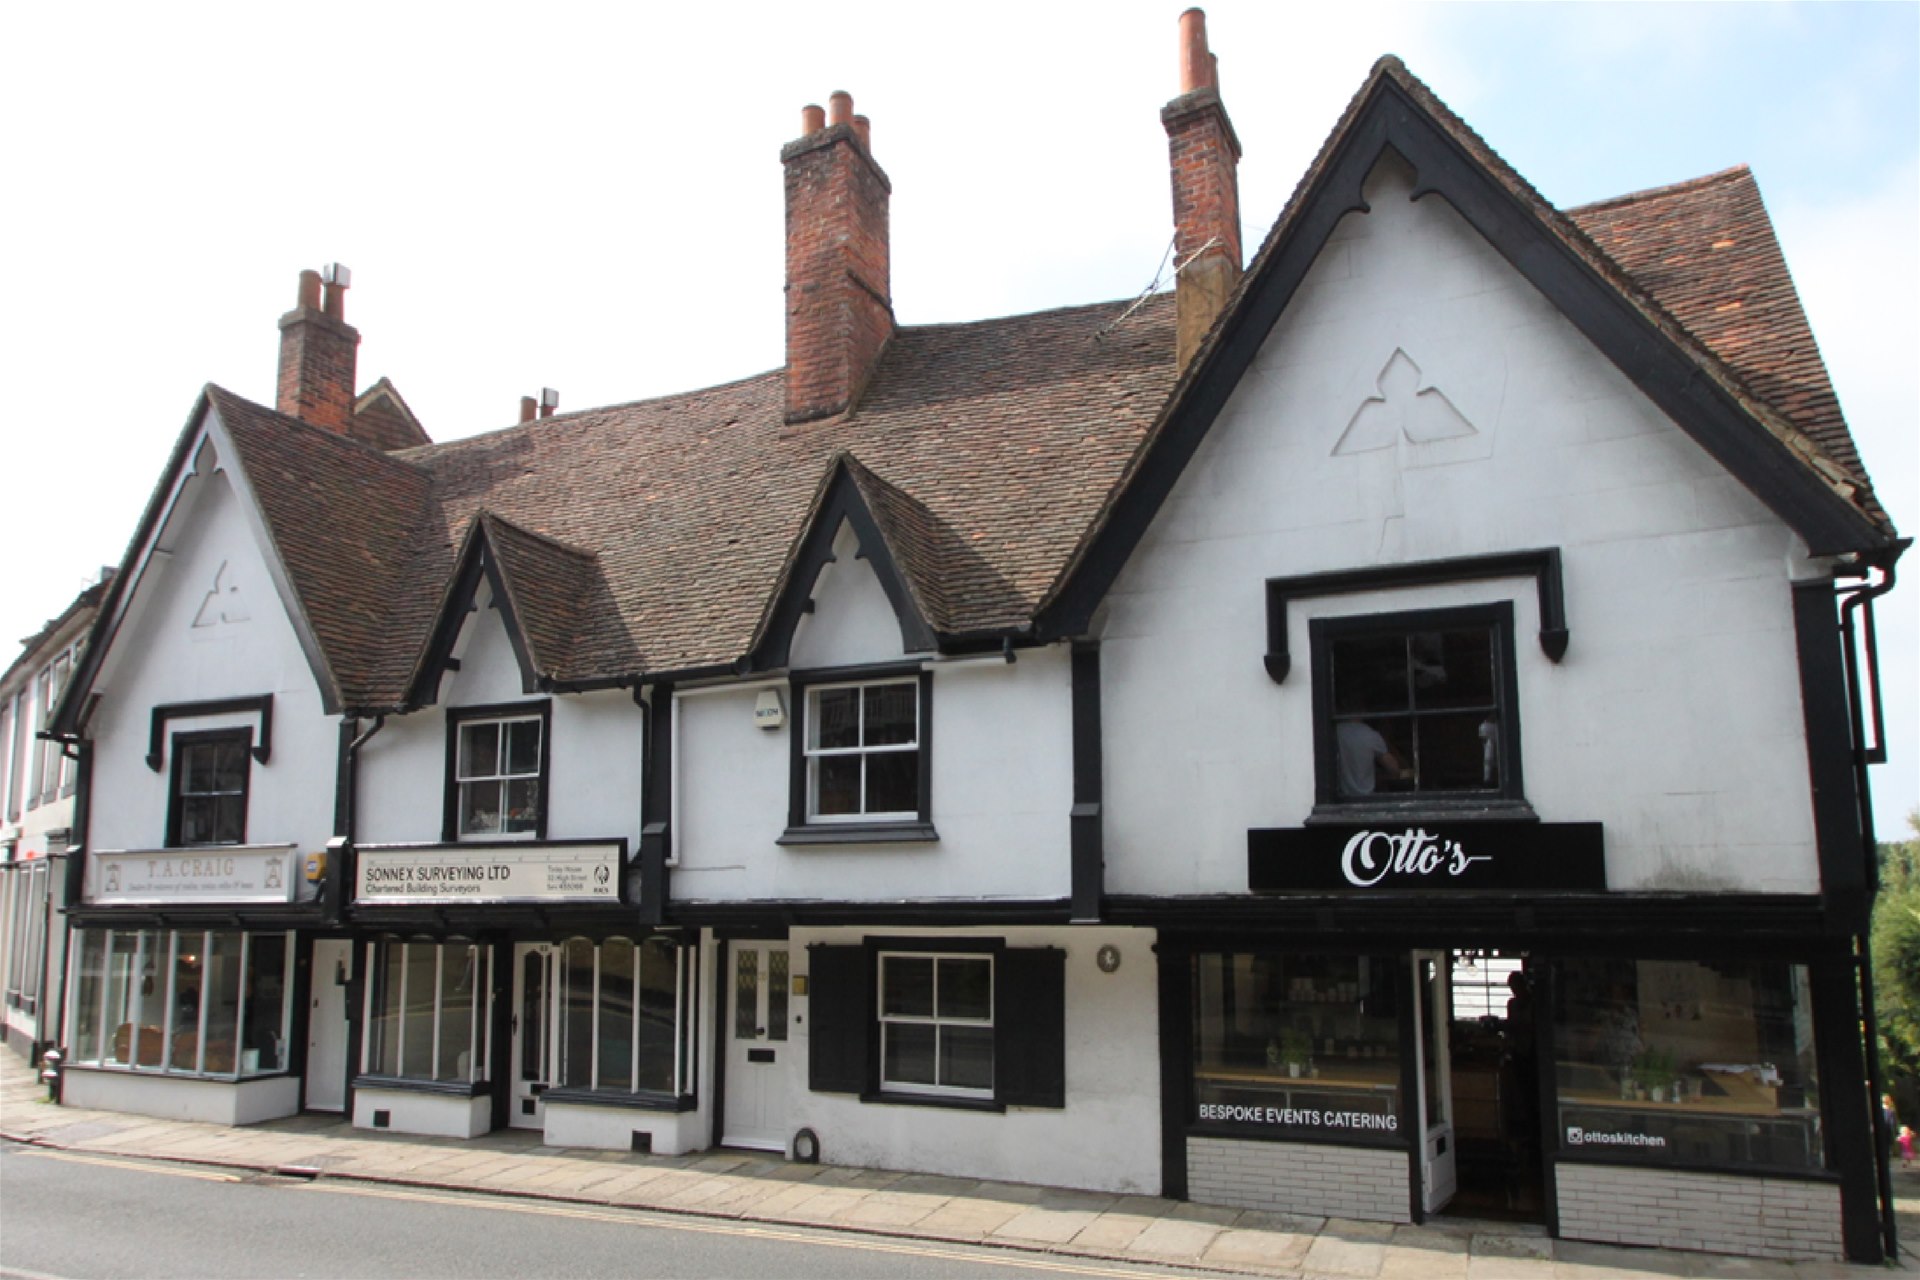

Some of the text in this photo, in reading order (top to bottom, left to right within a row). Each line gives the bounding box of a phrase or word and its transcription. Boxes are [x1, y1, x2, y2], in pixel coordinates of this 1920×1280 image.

[1341, 828, 1493, 887] Otto's
[366, 865, 511, 882] SONNEX SURVEYING LTD
[366, 882, 481, 896] Chartered Building Surveyors
[1199, 1104, 1398, 1131] BESPOKE EVENTS CATERING
[1584, 1130, 1666, 1147] ottoskitchen
